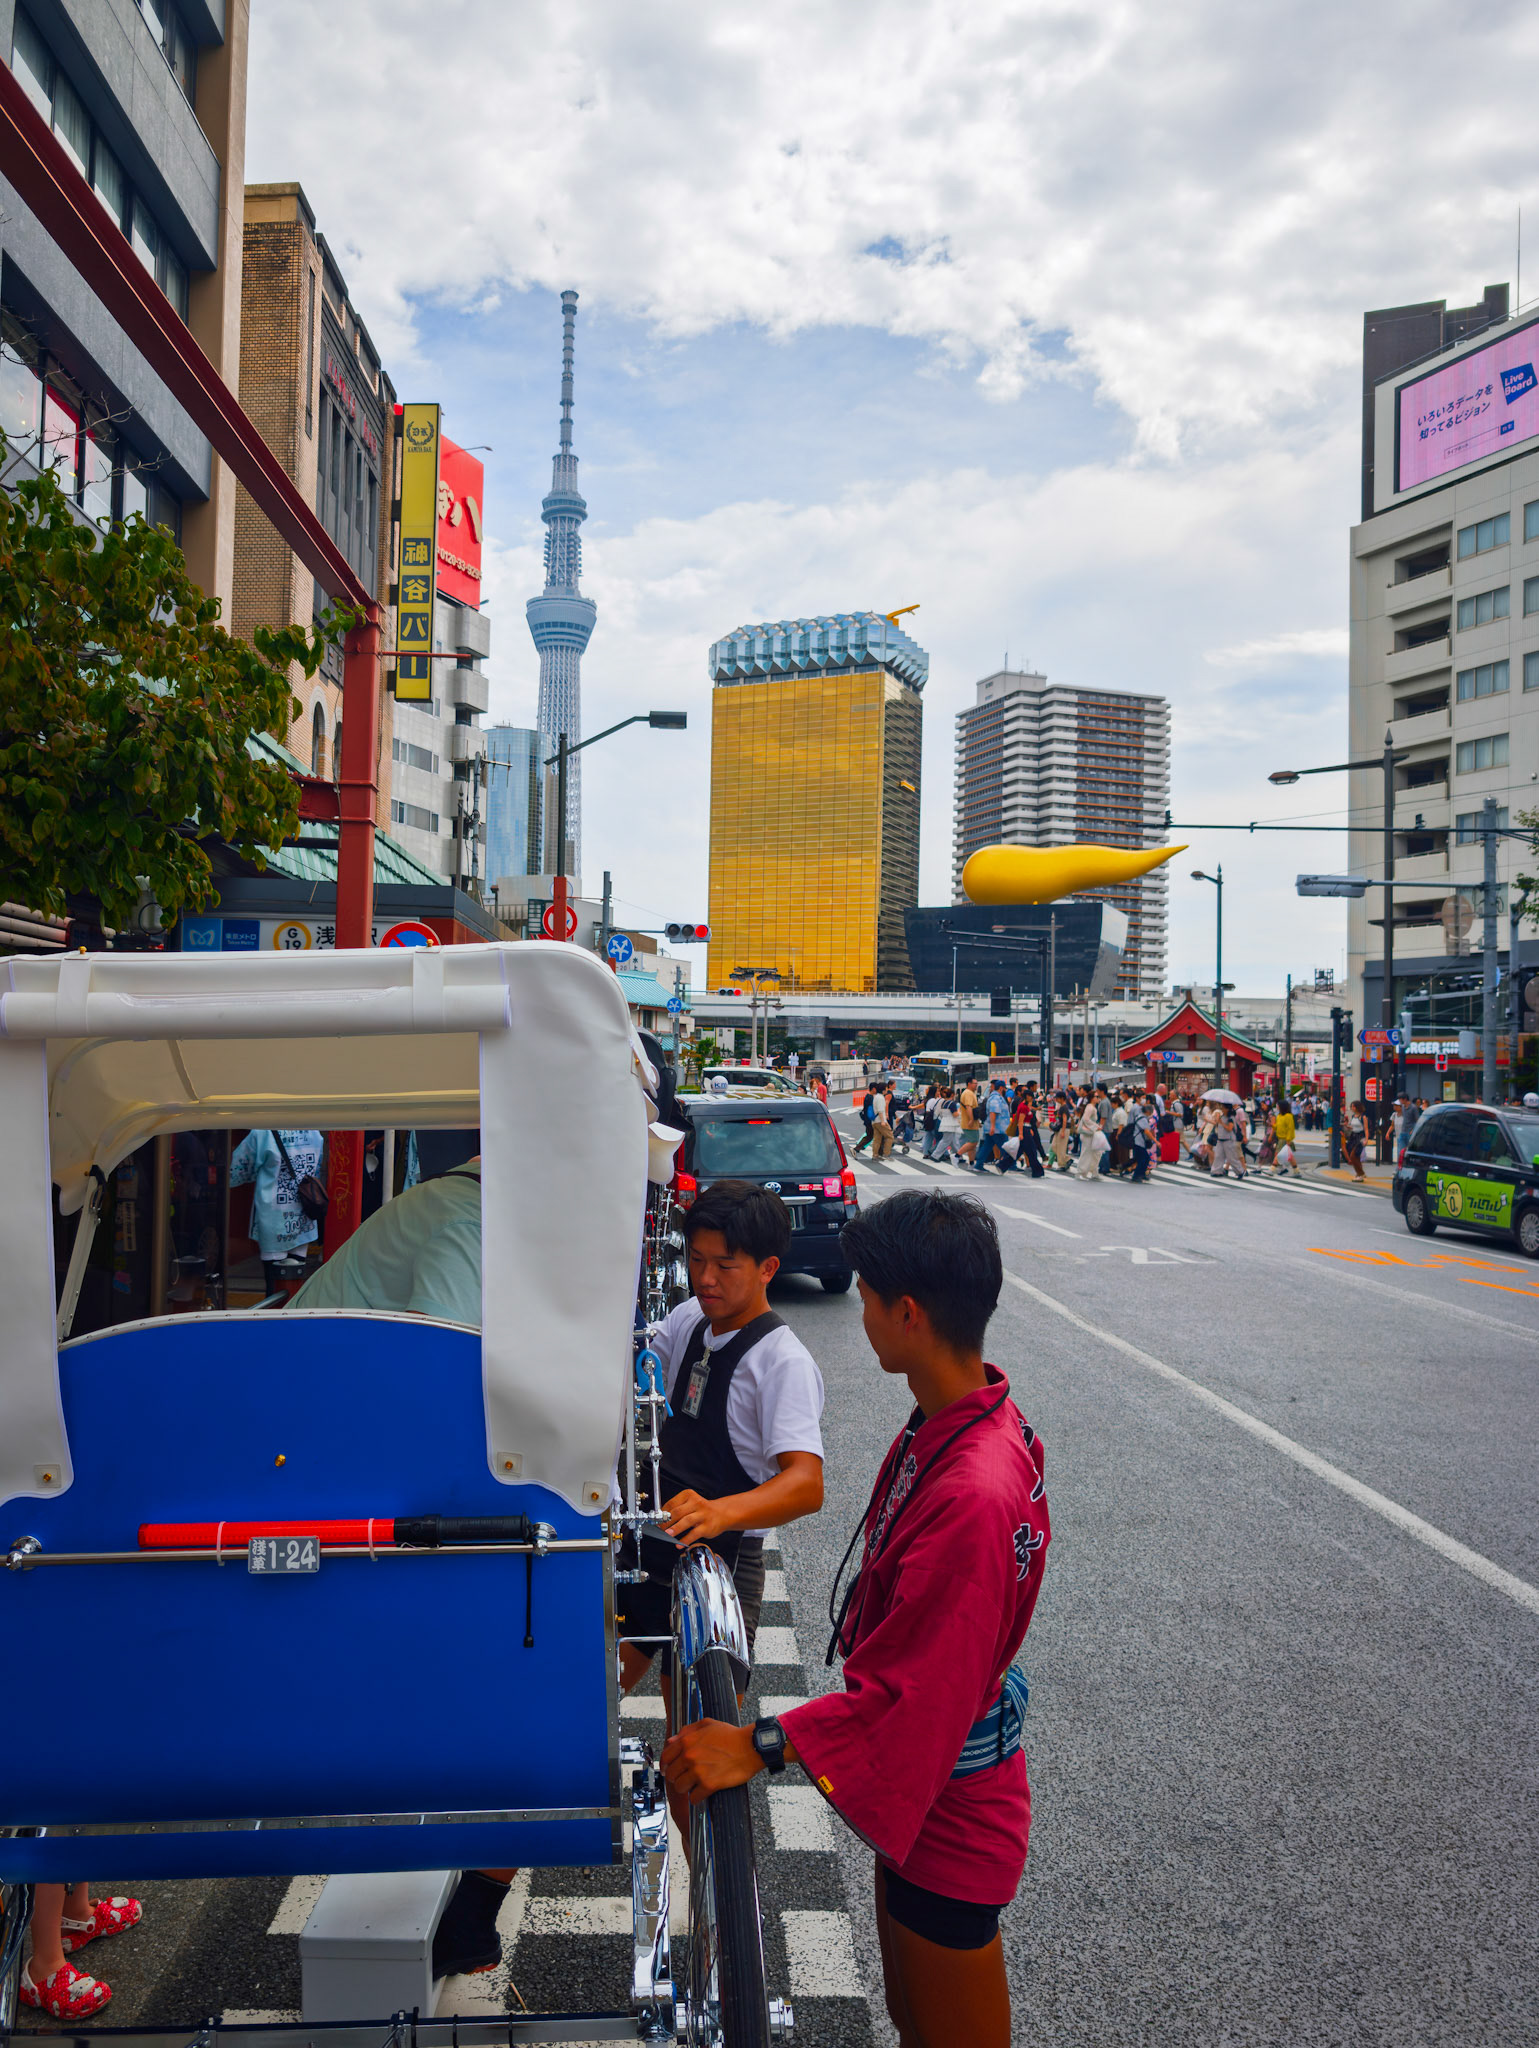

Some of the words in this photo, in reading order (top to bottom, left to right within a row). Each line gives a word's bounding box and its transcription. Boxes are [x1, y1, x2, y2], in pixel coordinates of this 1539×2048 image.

[1504, 372, 1525, 387] Live
[1505, 376, 1533, 396] Board
[1418, 384, 1494, 426] いろいろデータを
[1419, 402, 1491, 441] 知ってるビジョン
[402, 541, 428, 676] 神谷バー
[285, 939, 302, 949] 19
[287, 927, 298, 939] G
[268, 1540, 316, 1569] 1-24
